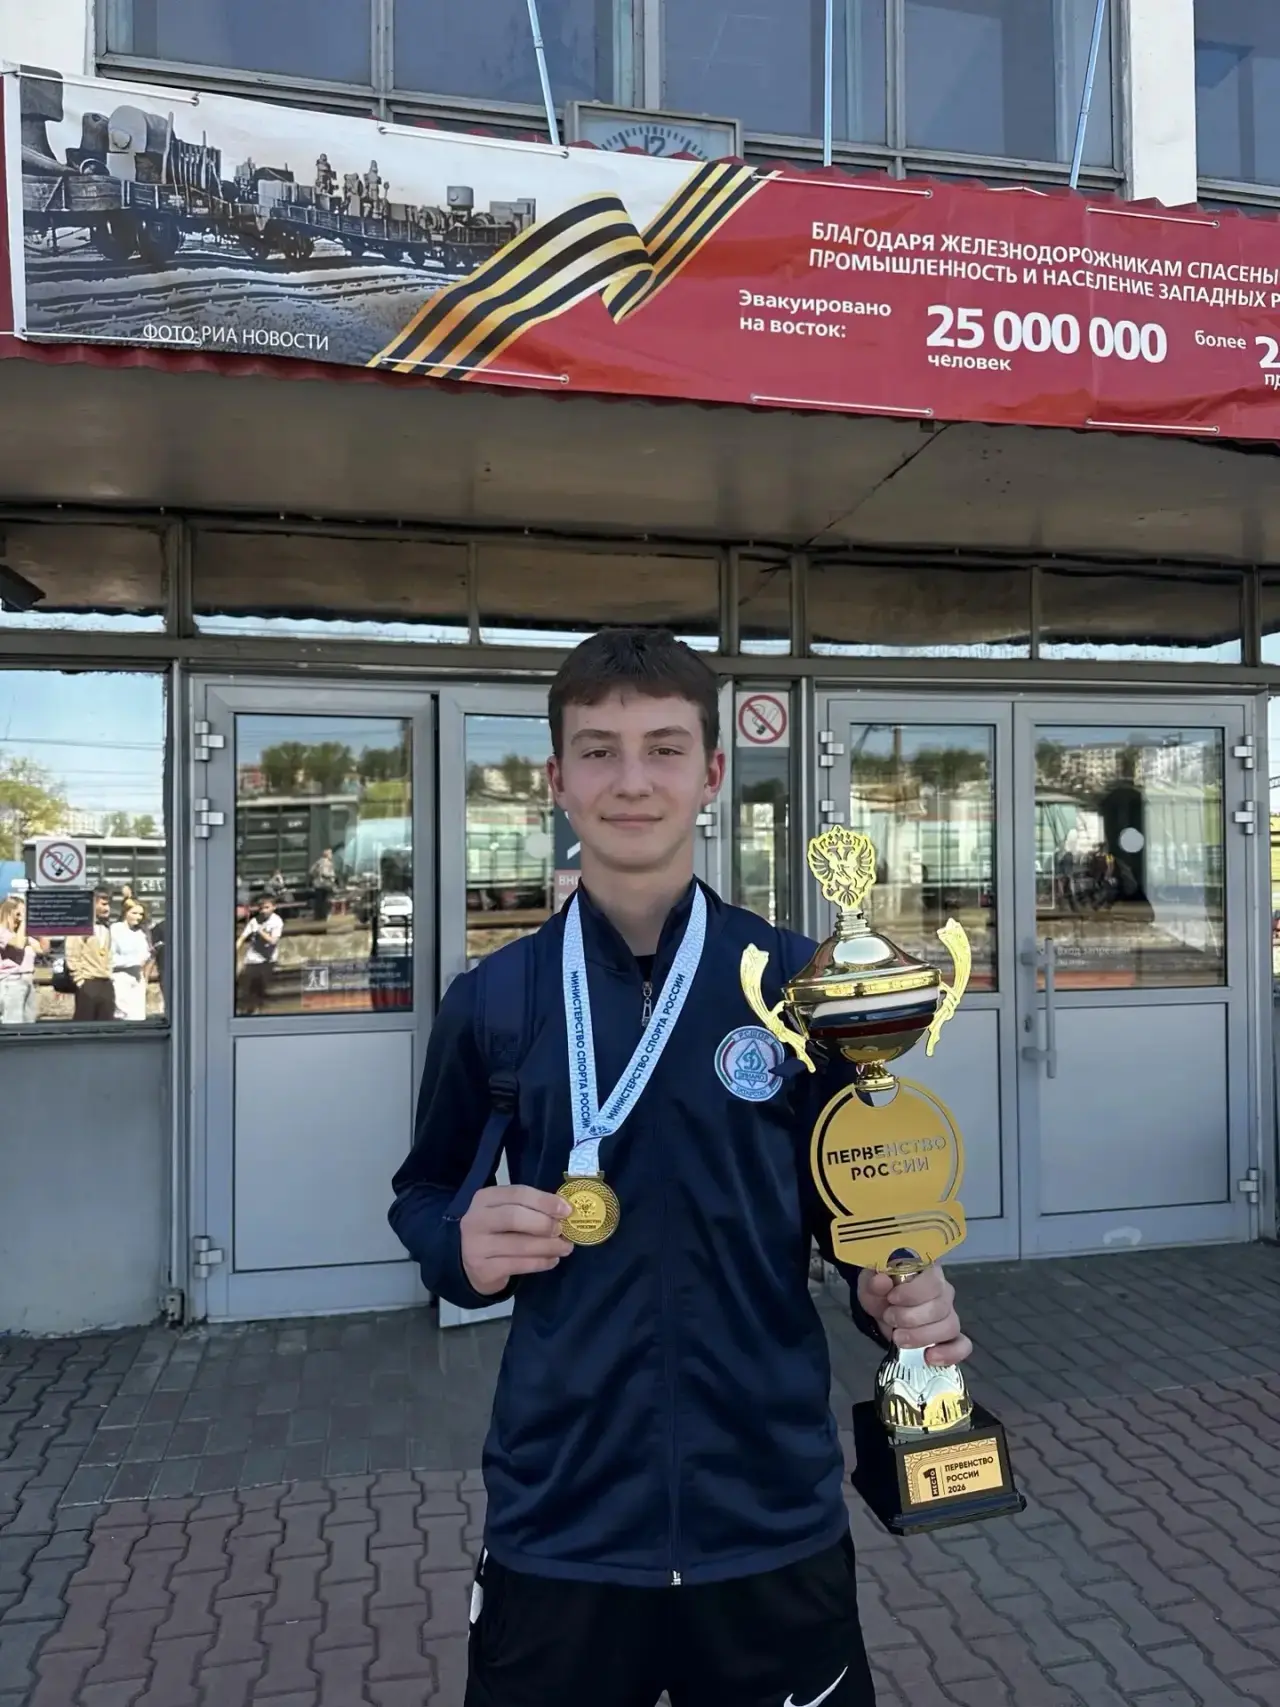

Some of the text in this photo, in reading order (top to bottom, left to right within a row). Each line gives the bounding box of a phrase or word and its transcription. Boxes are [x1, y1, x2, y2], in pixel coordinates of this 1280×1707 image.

[811, 221, 1279, 285] БЛАГОДАРЯ ЖЕЛЕЗНОДОРОЖНИКАМ СПАСЕНЫ
[809, 248, 1018, 284] ПРОМЫШЛЕННОСТЬ
[1023, 268, 1037, 284] И
[1043, 269, 1154, 297] НАСЕЛЕНИЕ
[1158, 283, 1267, 308] ЗАПАДНЫХ
[739, 289, 892, 317] Эвакуировано
[201, 325, 238, 344] РИА
[242, 328, 329, 351] НОВОСТИ
[739, 316, 846, 338] на восток:
[926, 304, 1168, 364] 25 000 000
[927, 354, 1012, 371] человек
[1194, 329, 1280, 369] более 2
[570, 970, 591, 1129] МИНИСТЕРСТВО СПОРТА РОССИИ
[606, 973, 686, 1121] МИНИСТЕРСТВО СПОРТА РОССИИ
[826, 1135, 947, 1165] ПЕРВЕНСТВО
[850, 1156, 929, 1181] РОССИИ
[944, 1456, 994, 1472] ПЕРВЕНСТВО
[946, 1470, 980, 1483] РОССИИ
[948, 1484, 966, 1494] 2026
